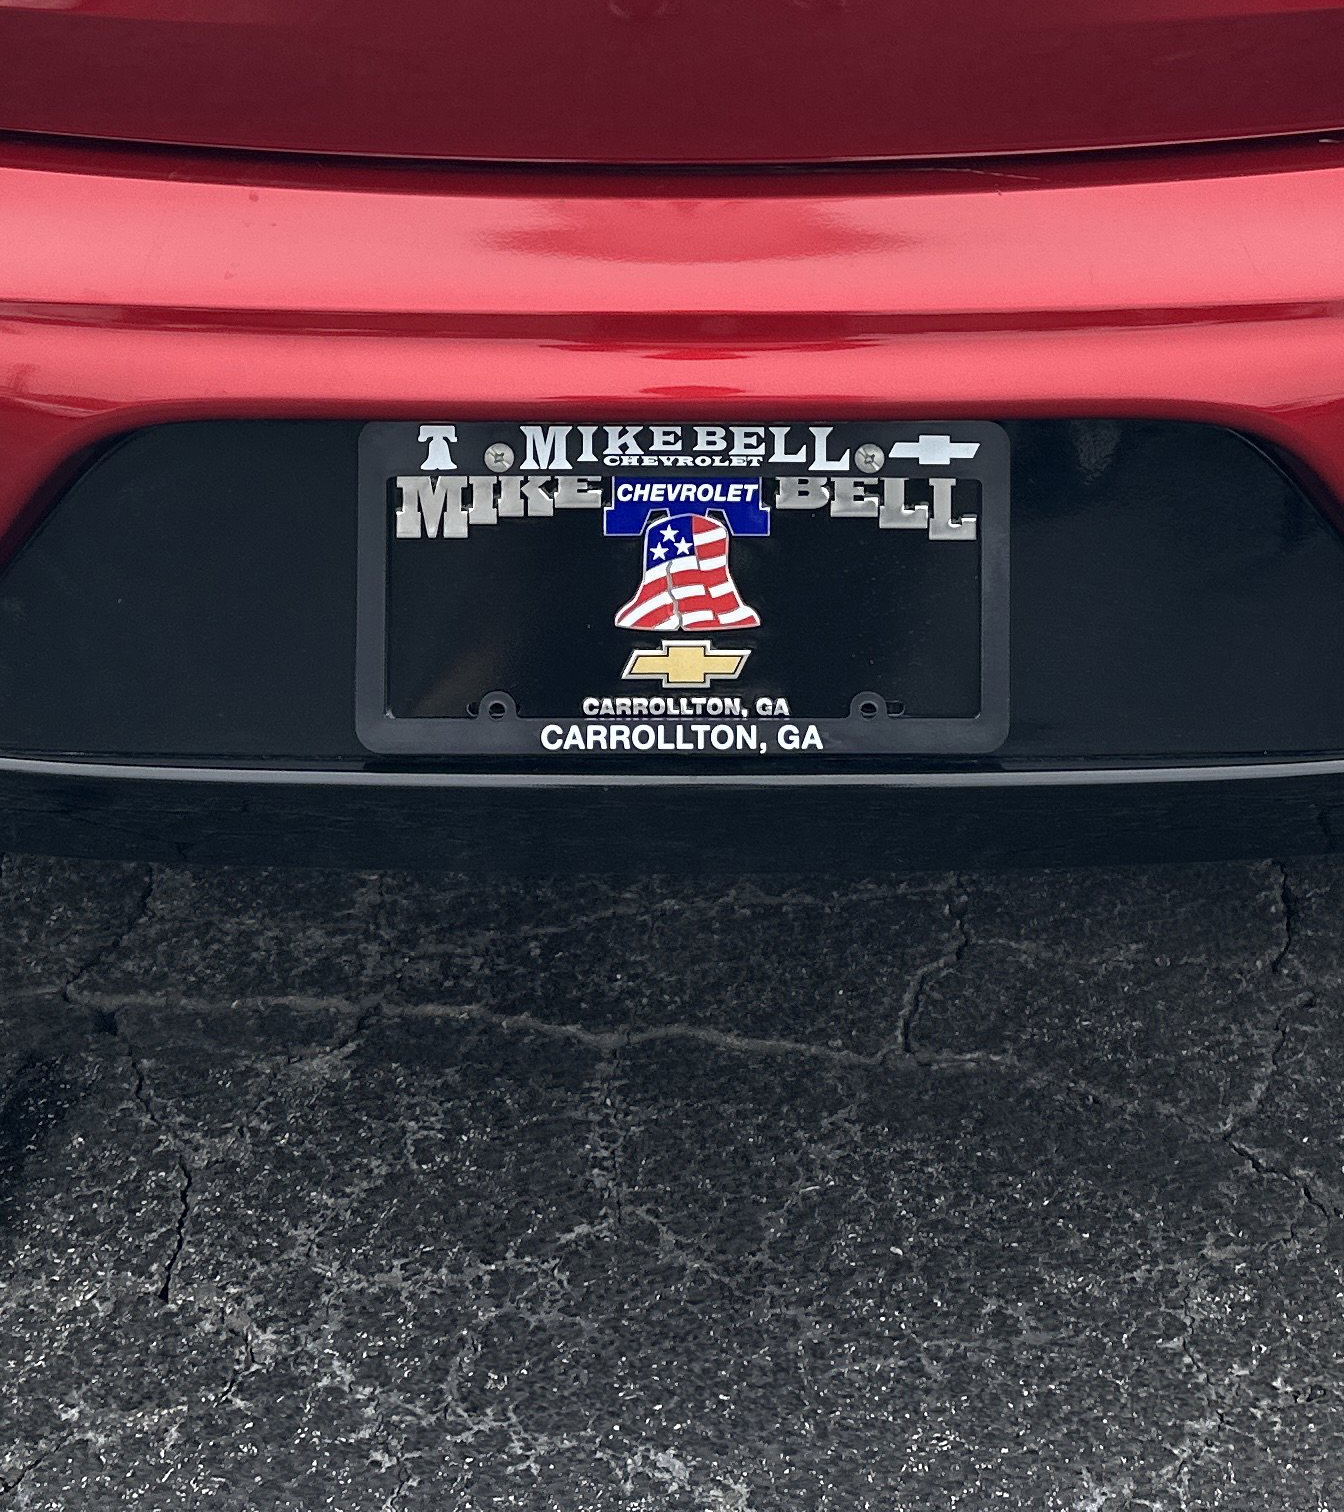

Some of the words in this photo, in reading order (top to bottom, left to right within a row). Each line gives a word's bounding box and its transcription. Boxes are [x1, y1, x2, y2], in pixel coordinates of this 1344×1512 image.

[519, 425, 682, 470] MIKE
[692, 426, 850, 471] BELL
[603, 455, 764, 467] CHEVROLET
[616, 483, 759, 502] CHEVROLET
[396, 475, 603, 539] MIKE
[775, 476, 978, 540] BELL
[582, 697, 749, 719] CARROLLTON,
[755, 697, 790, 716] GA
[540, 724, 768, 754] CARROLLTON,
[777, 724, 824, 750] GA
